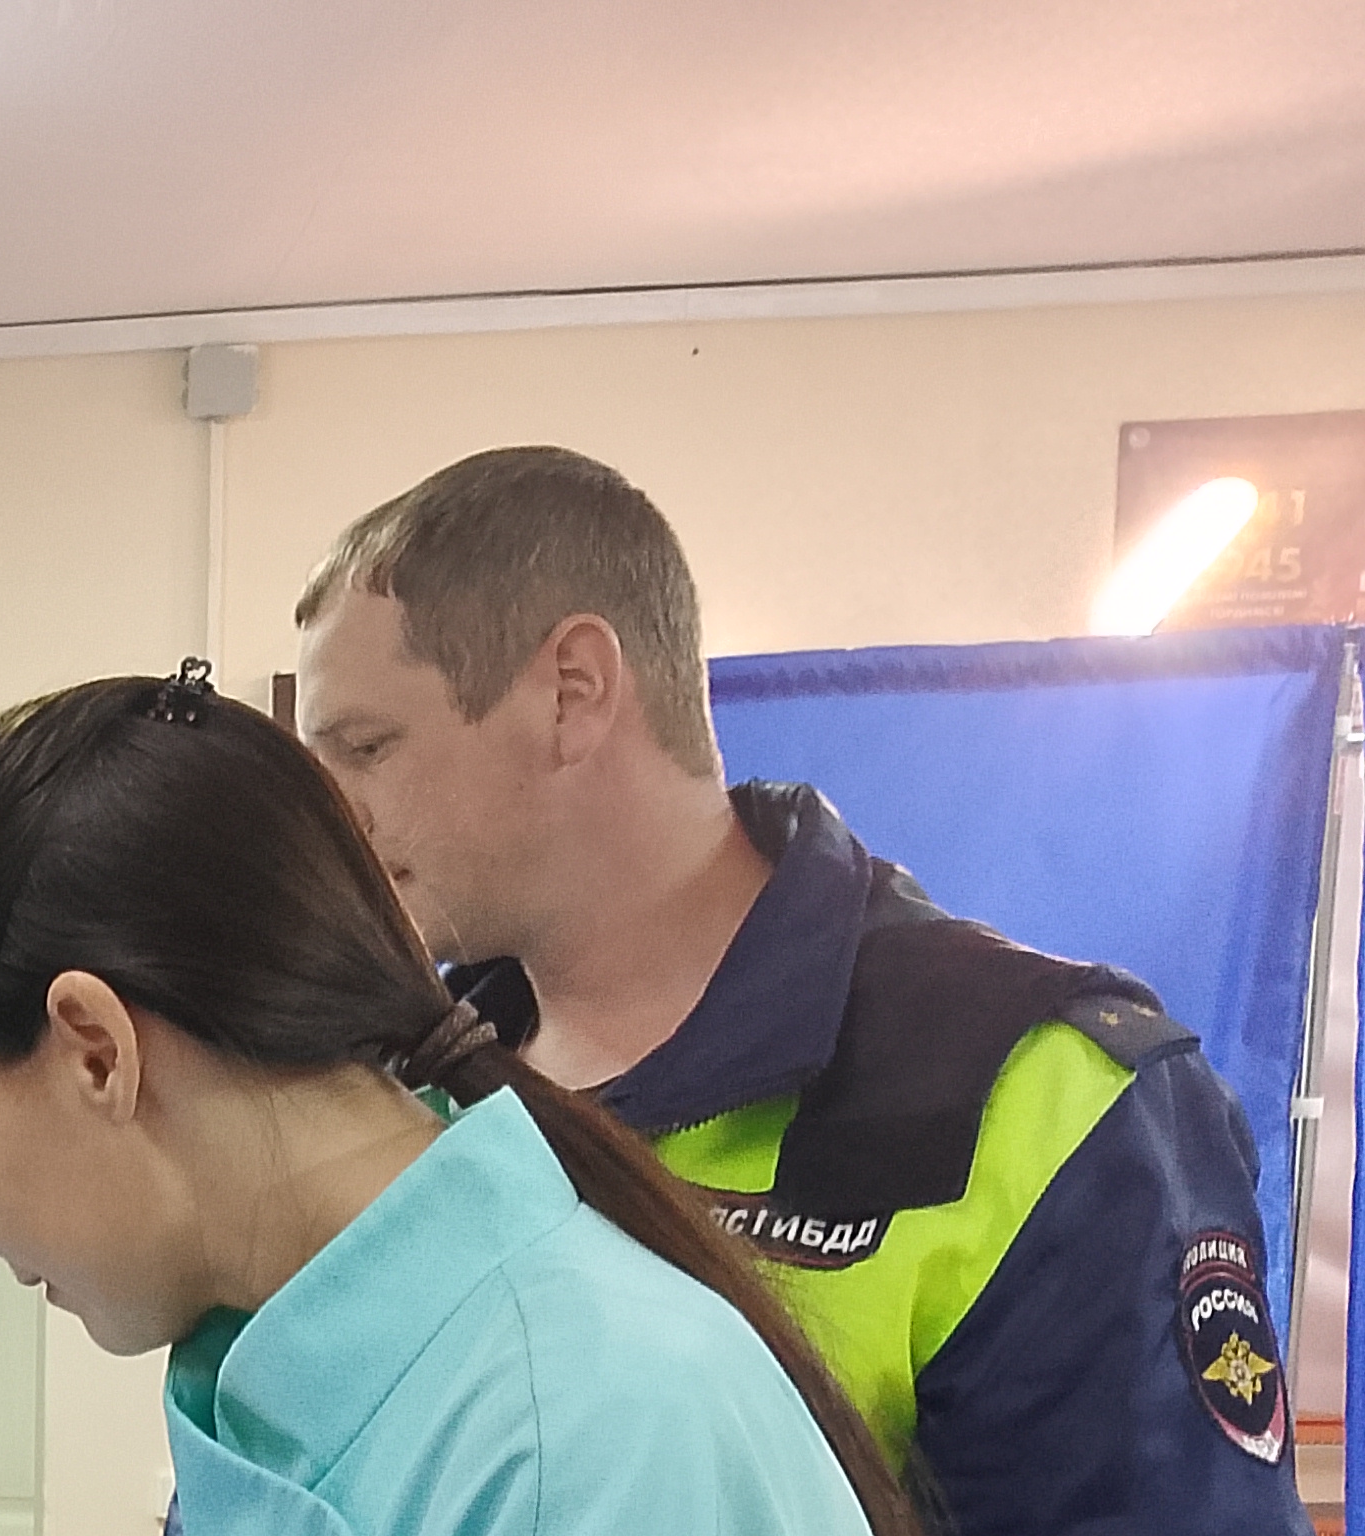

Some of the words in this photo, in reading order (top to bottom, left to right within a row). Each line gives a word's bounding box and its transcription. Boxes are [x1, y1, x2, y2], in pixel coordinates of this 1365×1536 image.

[709, 1207, 749, 1235] ПС
[1182, 1239, 1248, 1274] ПОЛИЦИЯ
[1191, 1287, 1259, 1333] РОССИЯ
